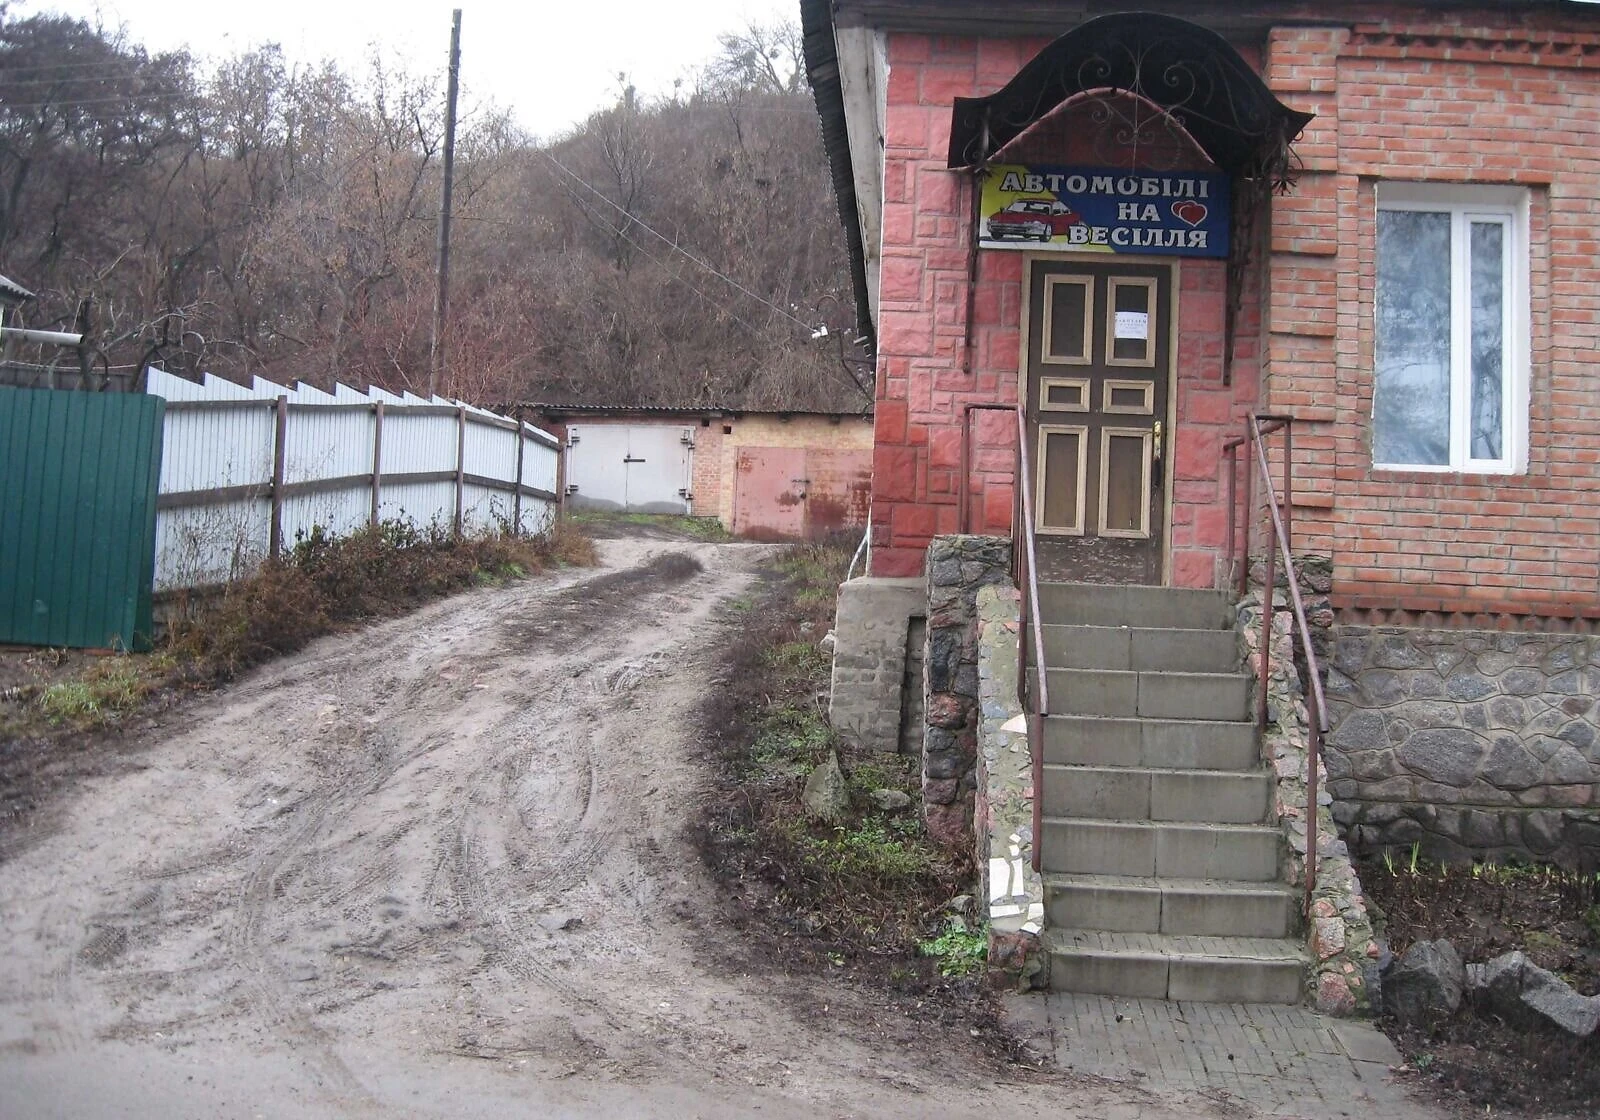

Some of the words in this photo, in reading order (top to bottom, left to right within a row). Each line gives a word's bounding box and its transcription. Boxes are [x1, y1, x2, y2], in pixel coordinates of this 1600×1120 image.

[1000, 172, 1209, 198] АВТОМОБІЛІ
[1117, 202, 1161, 222] НА
[1068, 225, 1208, 248] ВЕСІЛЛЯ
